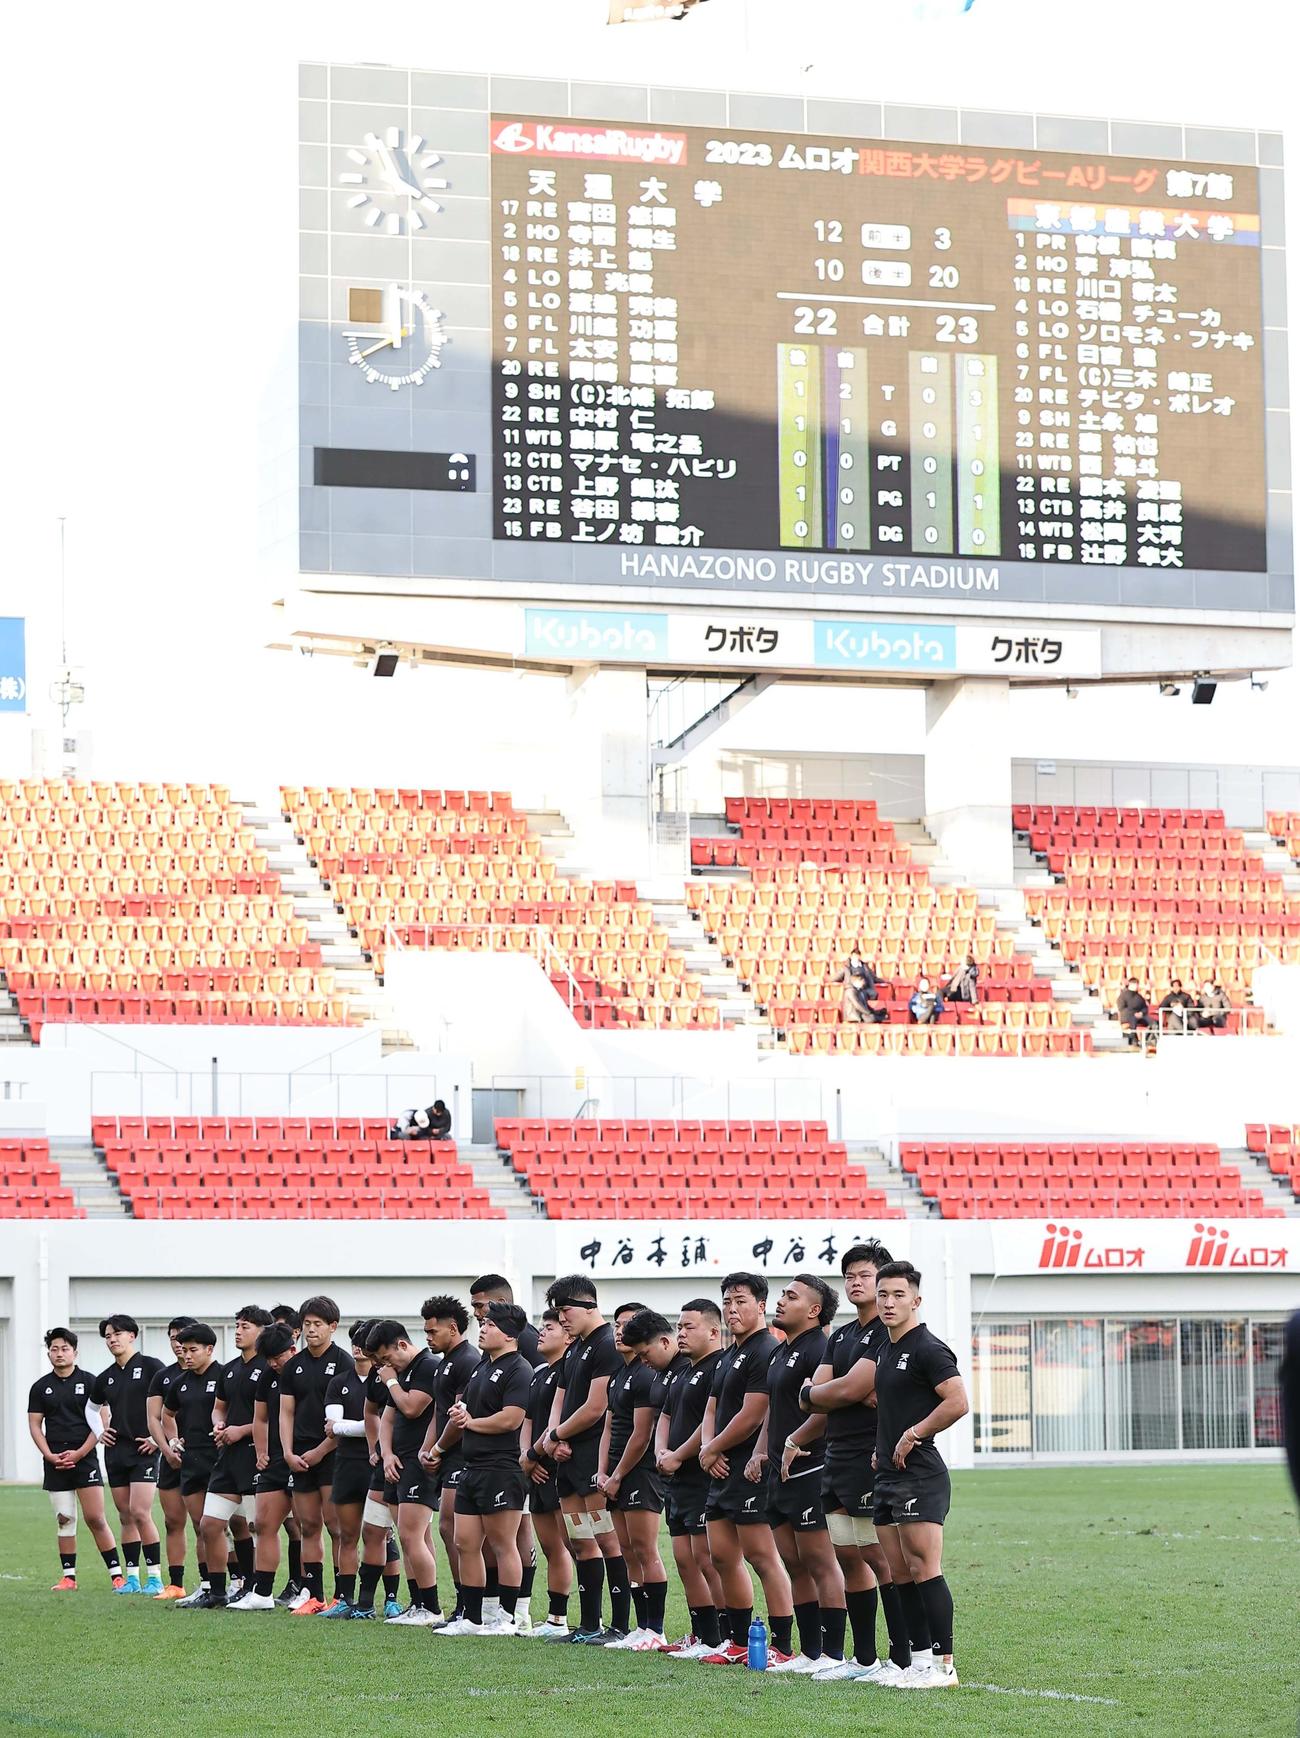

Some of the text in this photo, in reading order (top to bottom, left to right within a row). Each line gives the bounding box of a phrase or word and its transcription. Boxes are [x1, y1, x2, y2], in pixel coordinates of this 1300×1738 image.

[706, 140, 772, 166] 2023
[501, 200, 519, 215] 17
[526, 201, 557, 218] RE
[503, 222, 517, 239] 2
[526, 223, 560, 241] HO
[627, 228, 677, 250] 生
[814, 220, 842, 243] 12
[934, 227, 952, 250] 3
[1015, 232, 1024, 248] 1
[1036, 233, 1066, 250] PR
[527, 246, 558, 263] RE
[568, 246, 618, 269] 井上
[1015, 254, 1027, 270] 2
[1036, 255, 1068, 273] HO
[503, 268, 517, 284] 4
[528, 269, 561, 287] LO
[814, 258, 844, 281] 10
[929, 265, 959, 289] 20
[504, 291, 517, 307] 5
[528, 292, 561, 309] LO
[1037, 277, 1066, 294] RE
[1075, 277, 1121, 300] 川口
[504, 314, 517, 330] 6
[528, 314, 559, 332] FL
[1015, 299, 1028, 314] 4
[1038, 299, 1069, 317] LO
[1132, 305, 1221, 327] チューカ
[794, 306, 837, 336] 22
[935, 314, 979, 344] 23
[1016, 320, 1029, 337] 5
[1038, 321, 1069, 339] LO
[505, 336, 518, 352] 7
[528, 337, 559, 355] FL
[1016, 342, 1029, 359] 6
[1038, 343, 1068, 361] FL
[501, 359, 521, 375] 20
[528, 360, 559, 377] RE
[1017, 365, 1213, 393] 7 FL (C)三木 正
[505, 382, 518, 399] 9
[528, 383, 561, 400] SH
[571, 383, 655, 407] (C)北
[794, 380, 983, 407] 1 2 T 0 3
[1014, 387, 1033, 403] 20
[1039, 388, 1068, 405] RE
[502, 405, 655, 430] 22 RE 中村 仁
[794, 415, 982, 440] 1 1 G 0 1
[1018, 409, 1031, 425] 9
[1039, 409, 1070, 427] SH
[503, 428, 519, 444] 11
[525, 429, 562, 446] WTB
[1015, 431, 1034, 448] 23
[1040, 432, 1069, 449] RE
[503, 451, 736, 479] 12 CTB マナセ・ハビリ
[794, 450, 984, 476] 0 0 PT 0 0
[1016, 454, 1034, 470] 11
[1037, 455, 1072, 471] WTB
[503, 474, 522, 491] 13
[527, 475, 563, 492] CTB
[630, 477, 679, 499] 汰
[1016, 476, 1034, 492] 22
[1041, 476, 1070, 493] RE
[503, 497, 522, 514] 23
[529, 498, 560, 515] RE
[570, 498, 619, 520] 谷田
[796, 485, 983, 510] 1 0 PG 1 1
[1017, 498, 1036, 515] 13
[1038, 499, 1073, 516] CTB
[504, 521, 522, 537] 15
[530, 521, 562, 538] FB
[655, 524, 704, 546] 介
[794, 521, 985, 545] 0 0 DG 0 0
[1018, 521, 1036, 537] 14
[1037, 522, 1074, 538] WTB
[1018, 543, 1036, 559] 15
[1043, 543, 1073, 560] FB
[621, 553, 999, 590] HANAZONO RUGBY STADIUM
[533, 616, 656, 650] Kubota
[704, 624, 779, 654] クボタ
[826, 628, 944, 661] Kubota
[991, 636, 1063, 664] クボタ
[752, 1227, 885, 1269] 中谷本
[1084, 1248, 1145, 1267] ムロオ
[1230, 1247, 1288, 1267] ムロオ
